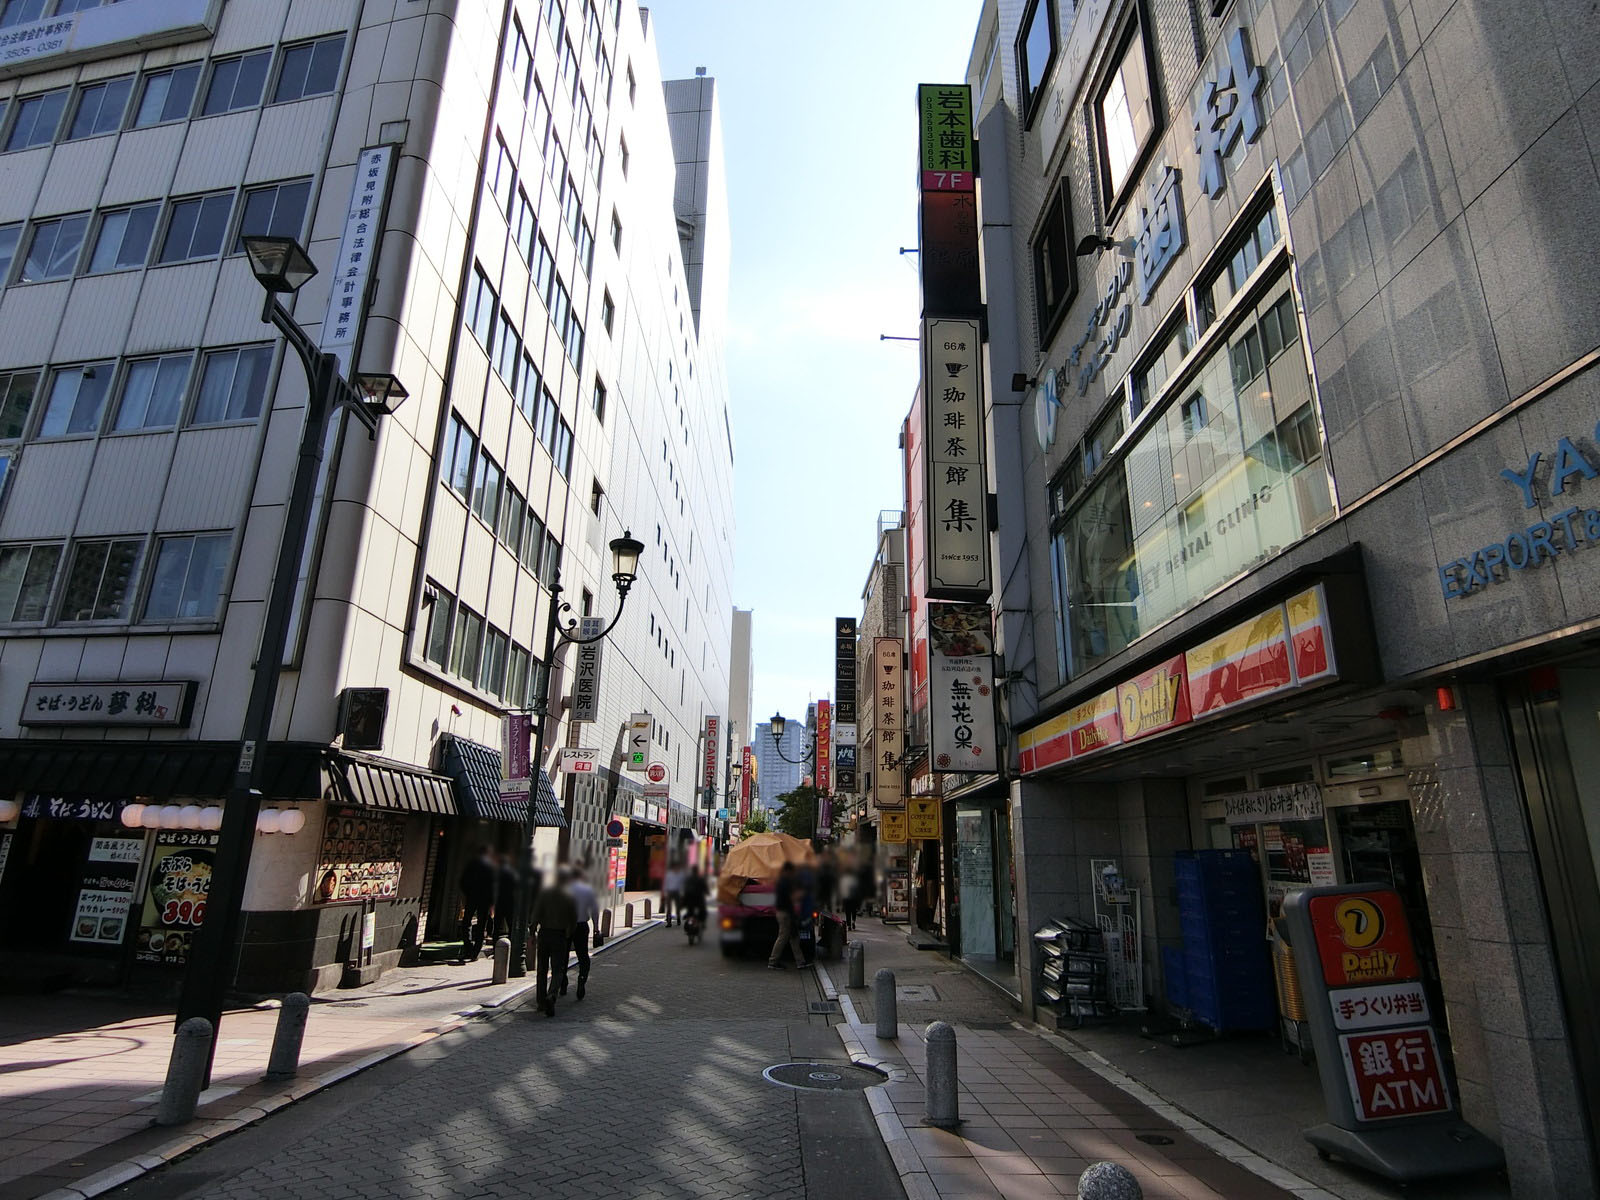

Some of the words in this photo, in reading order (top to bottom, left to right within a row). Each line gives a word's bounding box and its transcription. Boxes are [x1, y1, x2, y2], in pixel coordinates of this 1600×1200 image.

[0, 20, 73, 47] 合法律会計事務所
[938, 90, 968, 170] 岩本歯科
[934, 173, 962, 188] 7F
[334, 153, 382, 339] 赤坂見附総合法律会計事務所
[1501, 420, 1600, 509] YA
[576, 645, 597, 710] 岩沢医院
[951, 678, 974, 749] 無花果
[1122, 668, 1182, 738] Daily
[819, 707, 829, 758] パチンコ
[564, 751, 595, 759] レストラン
[160, 856, 193, 873] 天ぷら
[1342, 949, 1400, 979] Daily
[1339, 995, 1424, 1020] 手づくり弁当
[1358, 1037, 1426, 1076] 銀行
[1371, 1077, 1438, 1113] ATM
